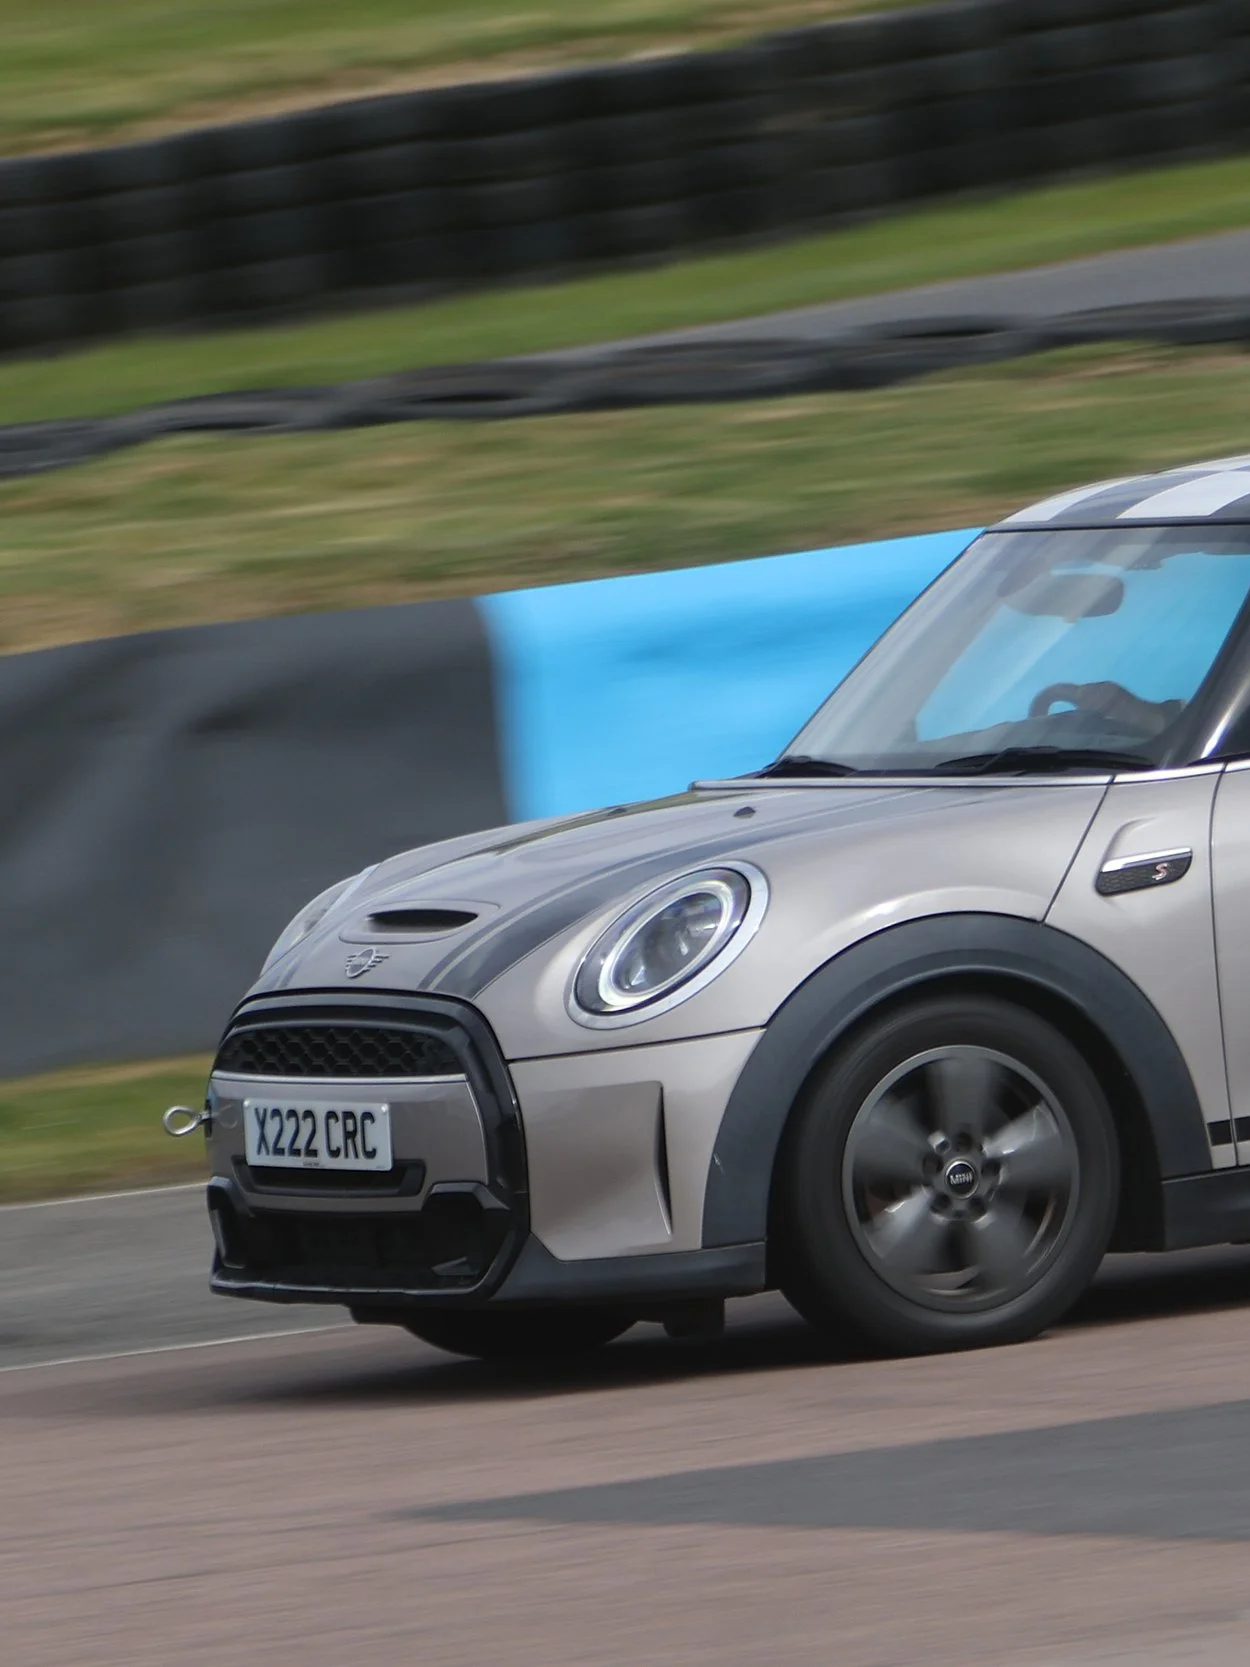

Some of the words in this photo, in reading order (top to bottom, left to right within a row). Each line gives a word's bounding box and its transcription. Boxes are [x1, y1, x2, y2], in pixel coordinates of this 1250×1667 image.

[1152, 863, 1169, 880] S
[254, 1107, 318, 1158] X222
[324, 1110, 377, 1159] CRC
